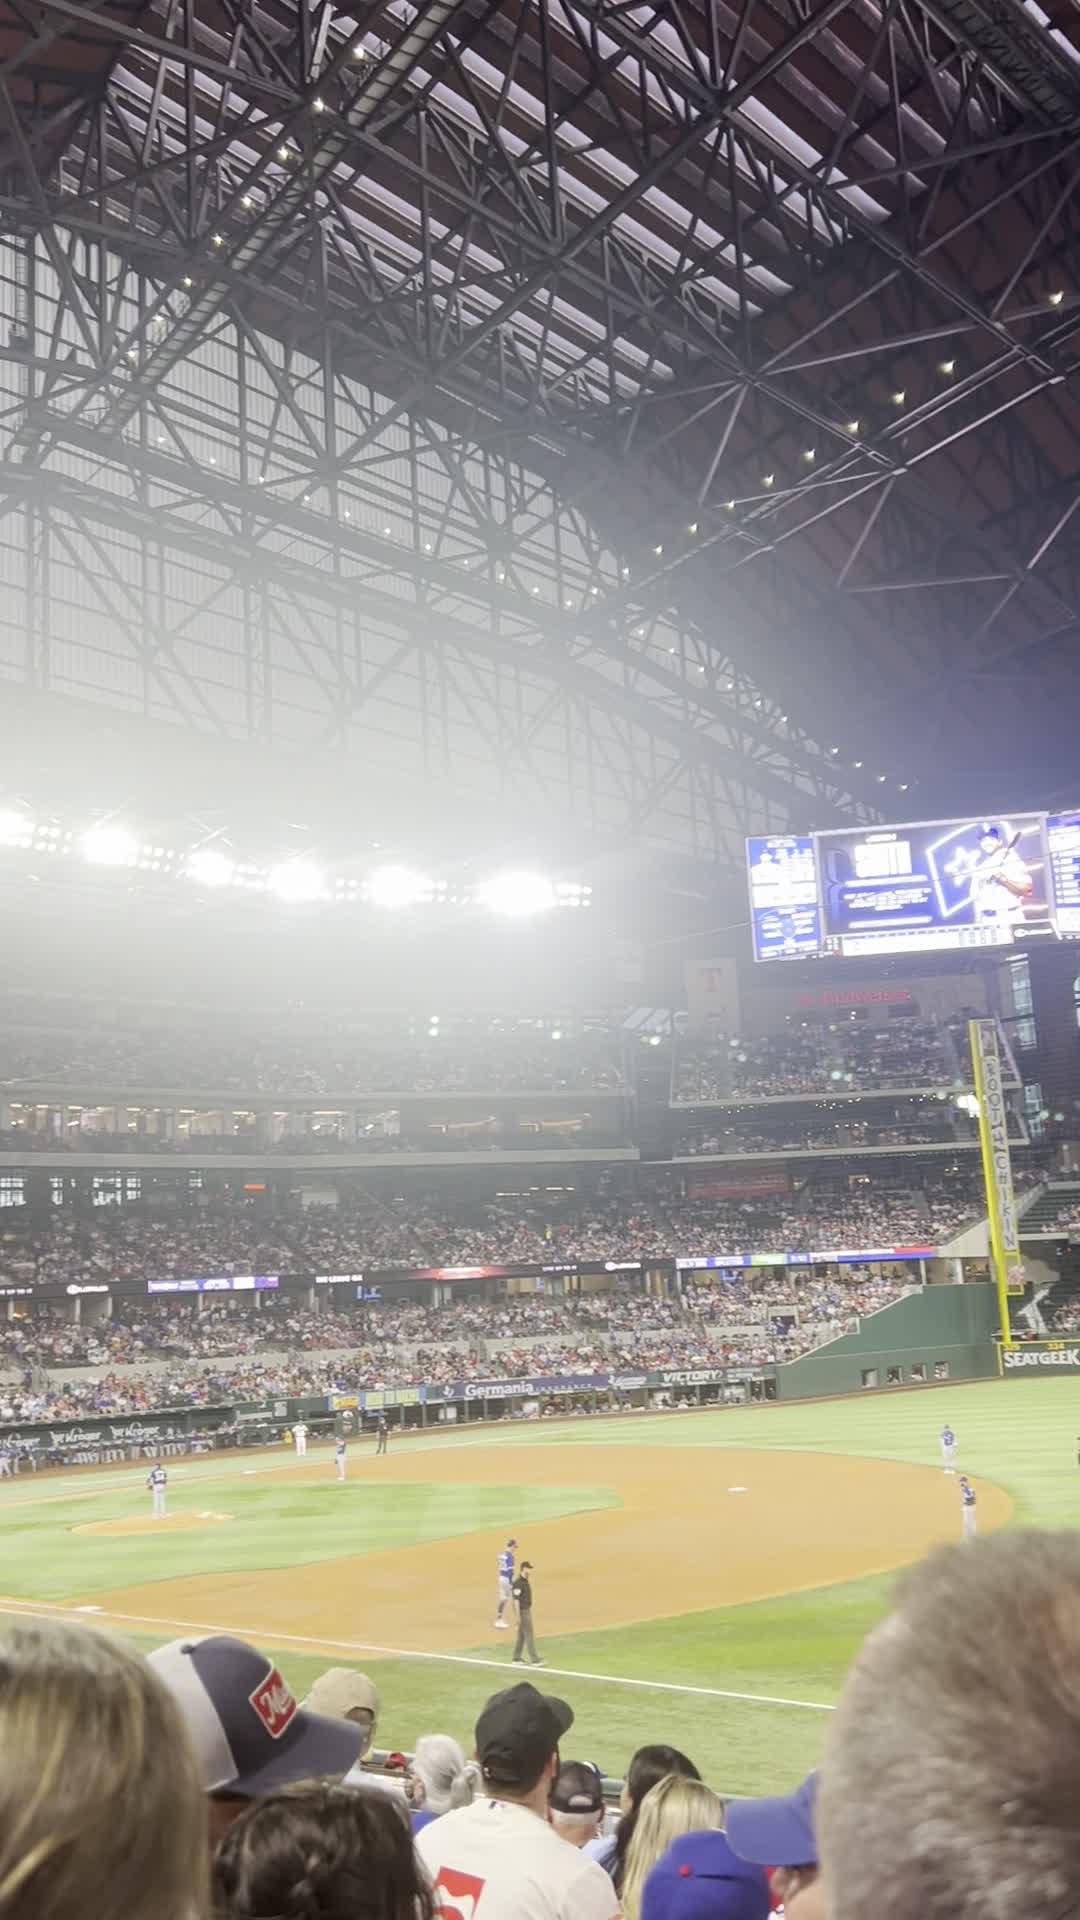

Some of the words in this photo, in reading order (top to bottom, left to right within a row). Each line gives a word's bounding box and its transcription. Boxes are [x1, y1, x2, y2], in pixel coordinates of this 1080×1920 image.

[1003, 1348, 1080, 1368] SEATGEEK
[465, 1381, 534, 1397] Germania
[65, 1427, 102, 1443] Kroger
[125, 1422, 160, 1438] Kroger
